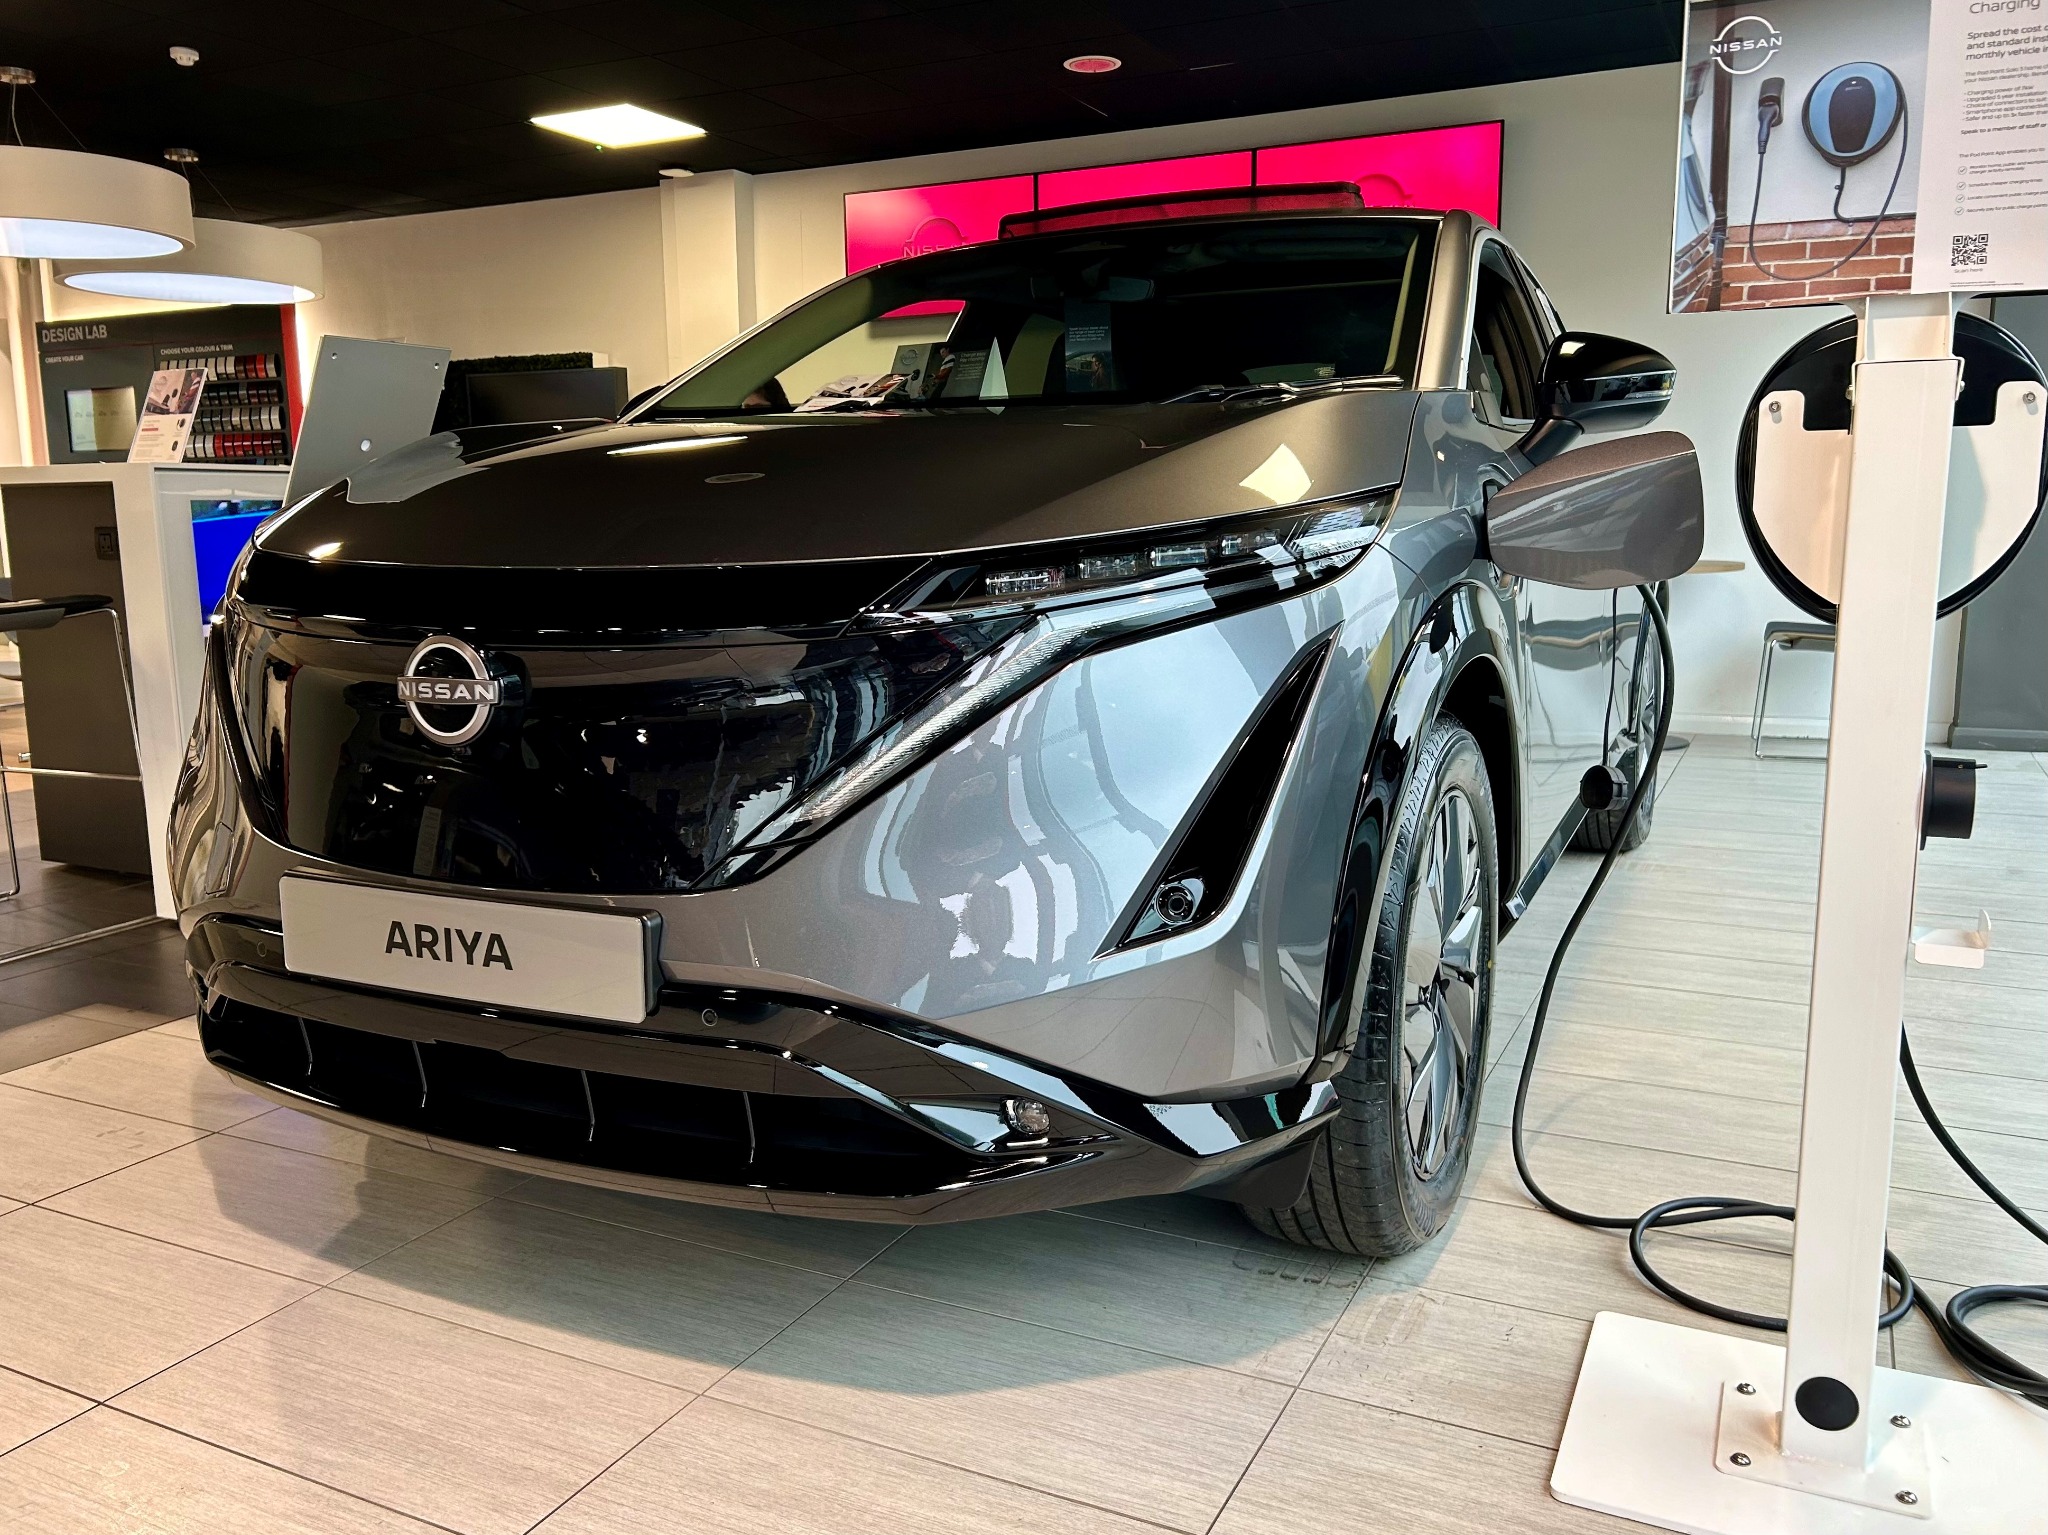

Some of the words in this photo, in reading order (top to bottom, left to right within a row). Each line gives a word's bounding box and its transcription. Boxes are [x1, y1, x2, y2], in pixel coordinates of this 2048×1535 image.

[1970, 0, 2040, 14] Charging
[1968, 29, 2001, 40] Spread
[2021, 25, 2041, 33] cost
[1709, 37, 1782, 54] NISSAN
[1967, 42, 1985, 50] and
[1987, 37, 2031, 47] standard
[1966, 51, 2005, 60] monthly
[2008, 47, 2040, 56] vehicle
[42, 327, 83, 343] DESIGN
[85, 325, 107, 339] LAB
[398, 681, 494, 700] NISSAN
[385, 920, 513, 970] ARIYA
